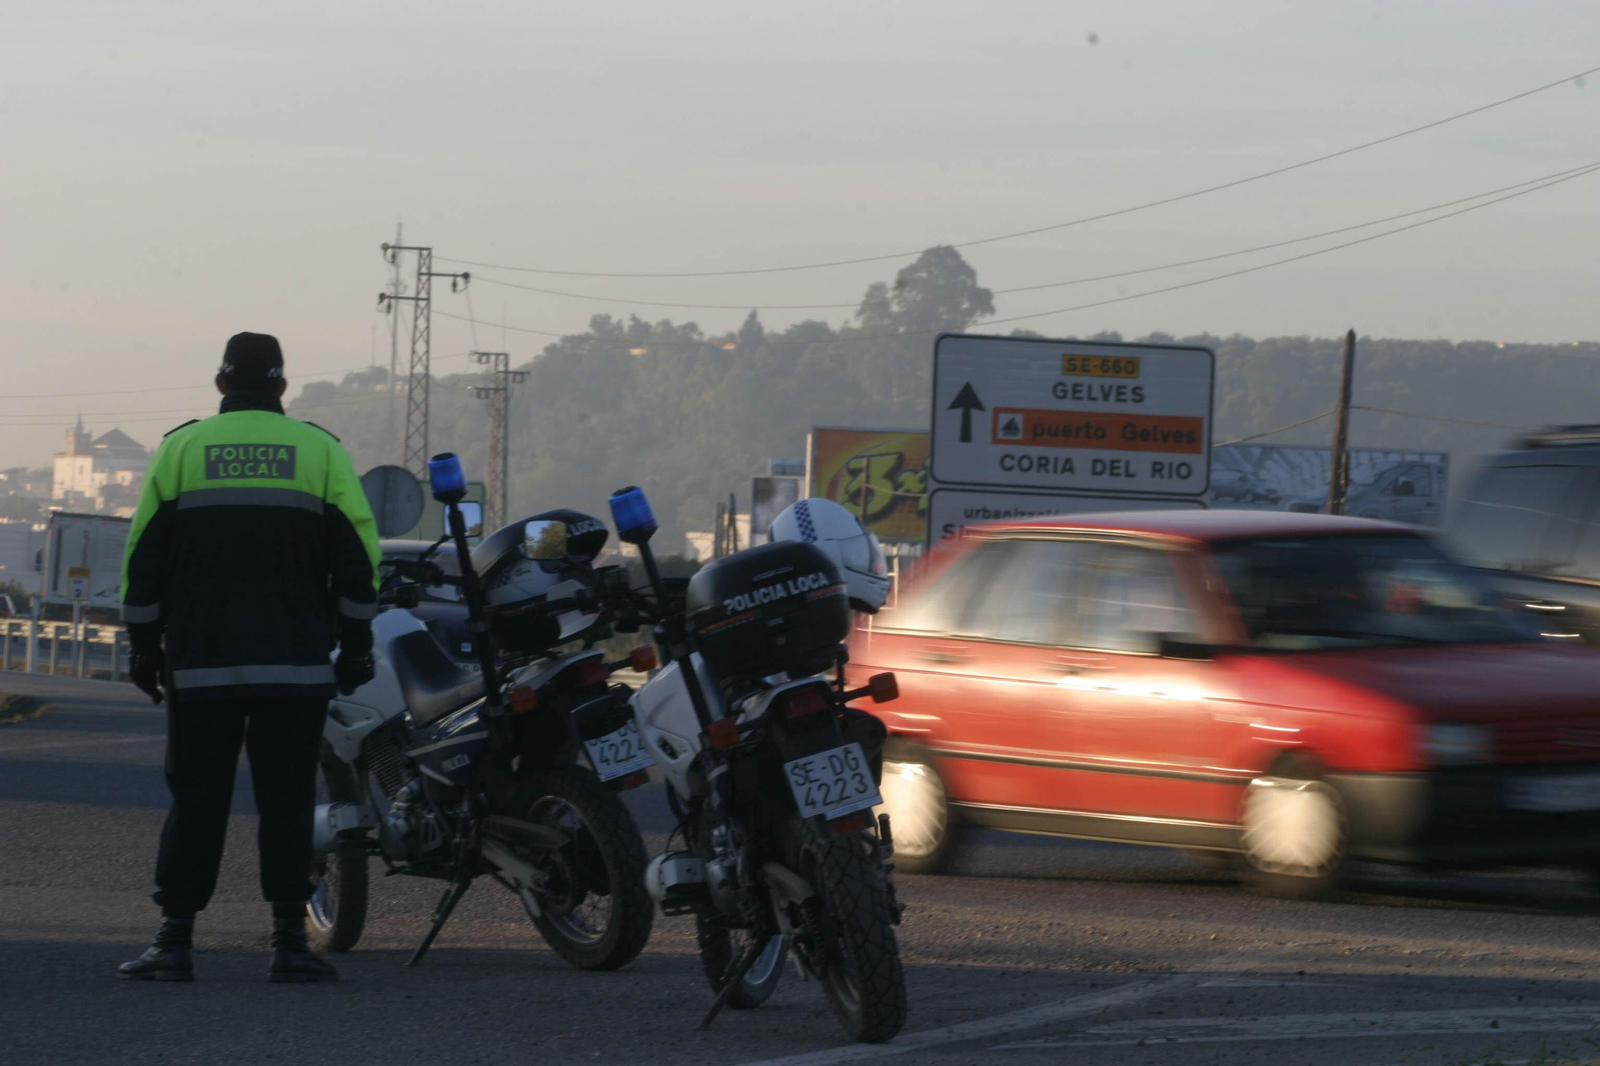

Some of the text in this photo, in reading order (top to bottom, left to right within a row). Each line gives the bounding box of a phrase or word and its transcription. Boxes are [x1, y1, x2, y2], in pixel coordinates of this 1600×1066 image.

[1066, 357, 1137, 375] SE-660
[1052, 381, 1145, 403] GELVES
[1032, 422, 1197, 445] puerto Gelves
[218, 462, 280, 477] LOCAL
[999, 453, 1192, 480] CORIA DEL RIO
[722, 584, 787, 614] POLICIA
[805, 772, 868, 809] 4223
